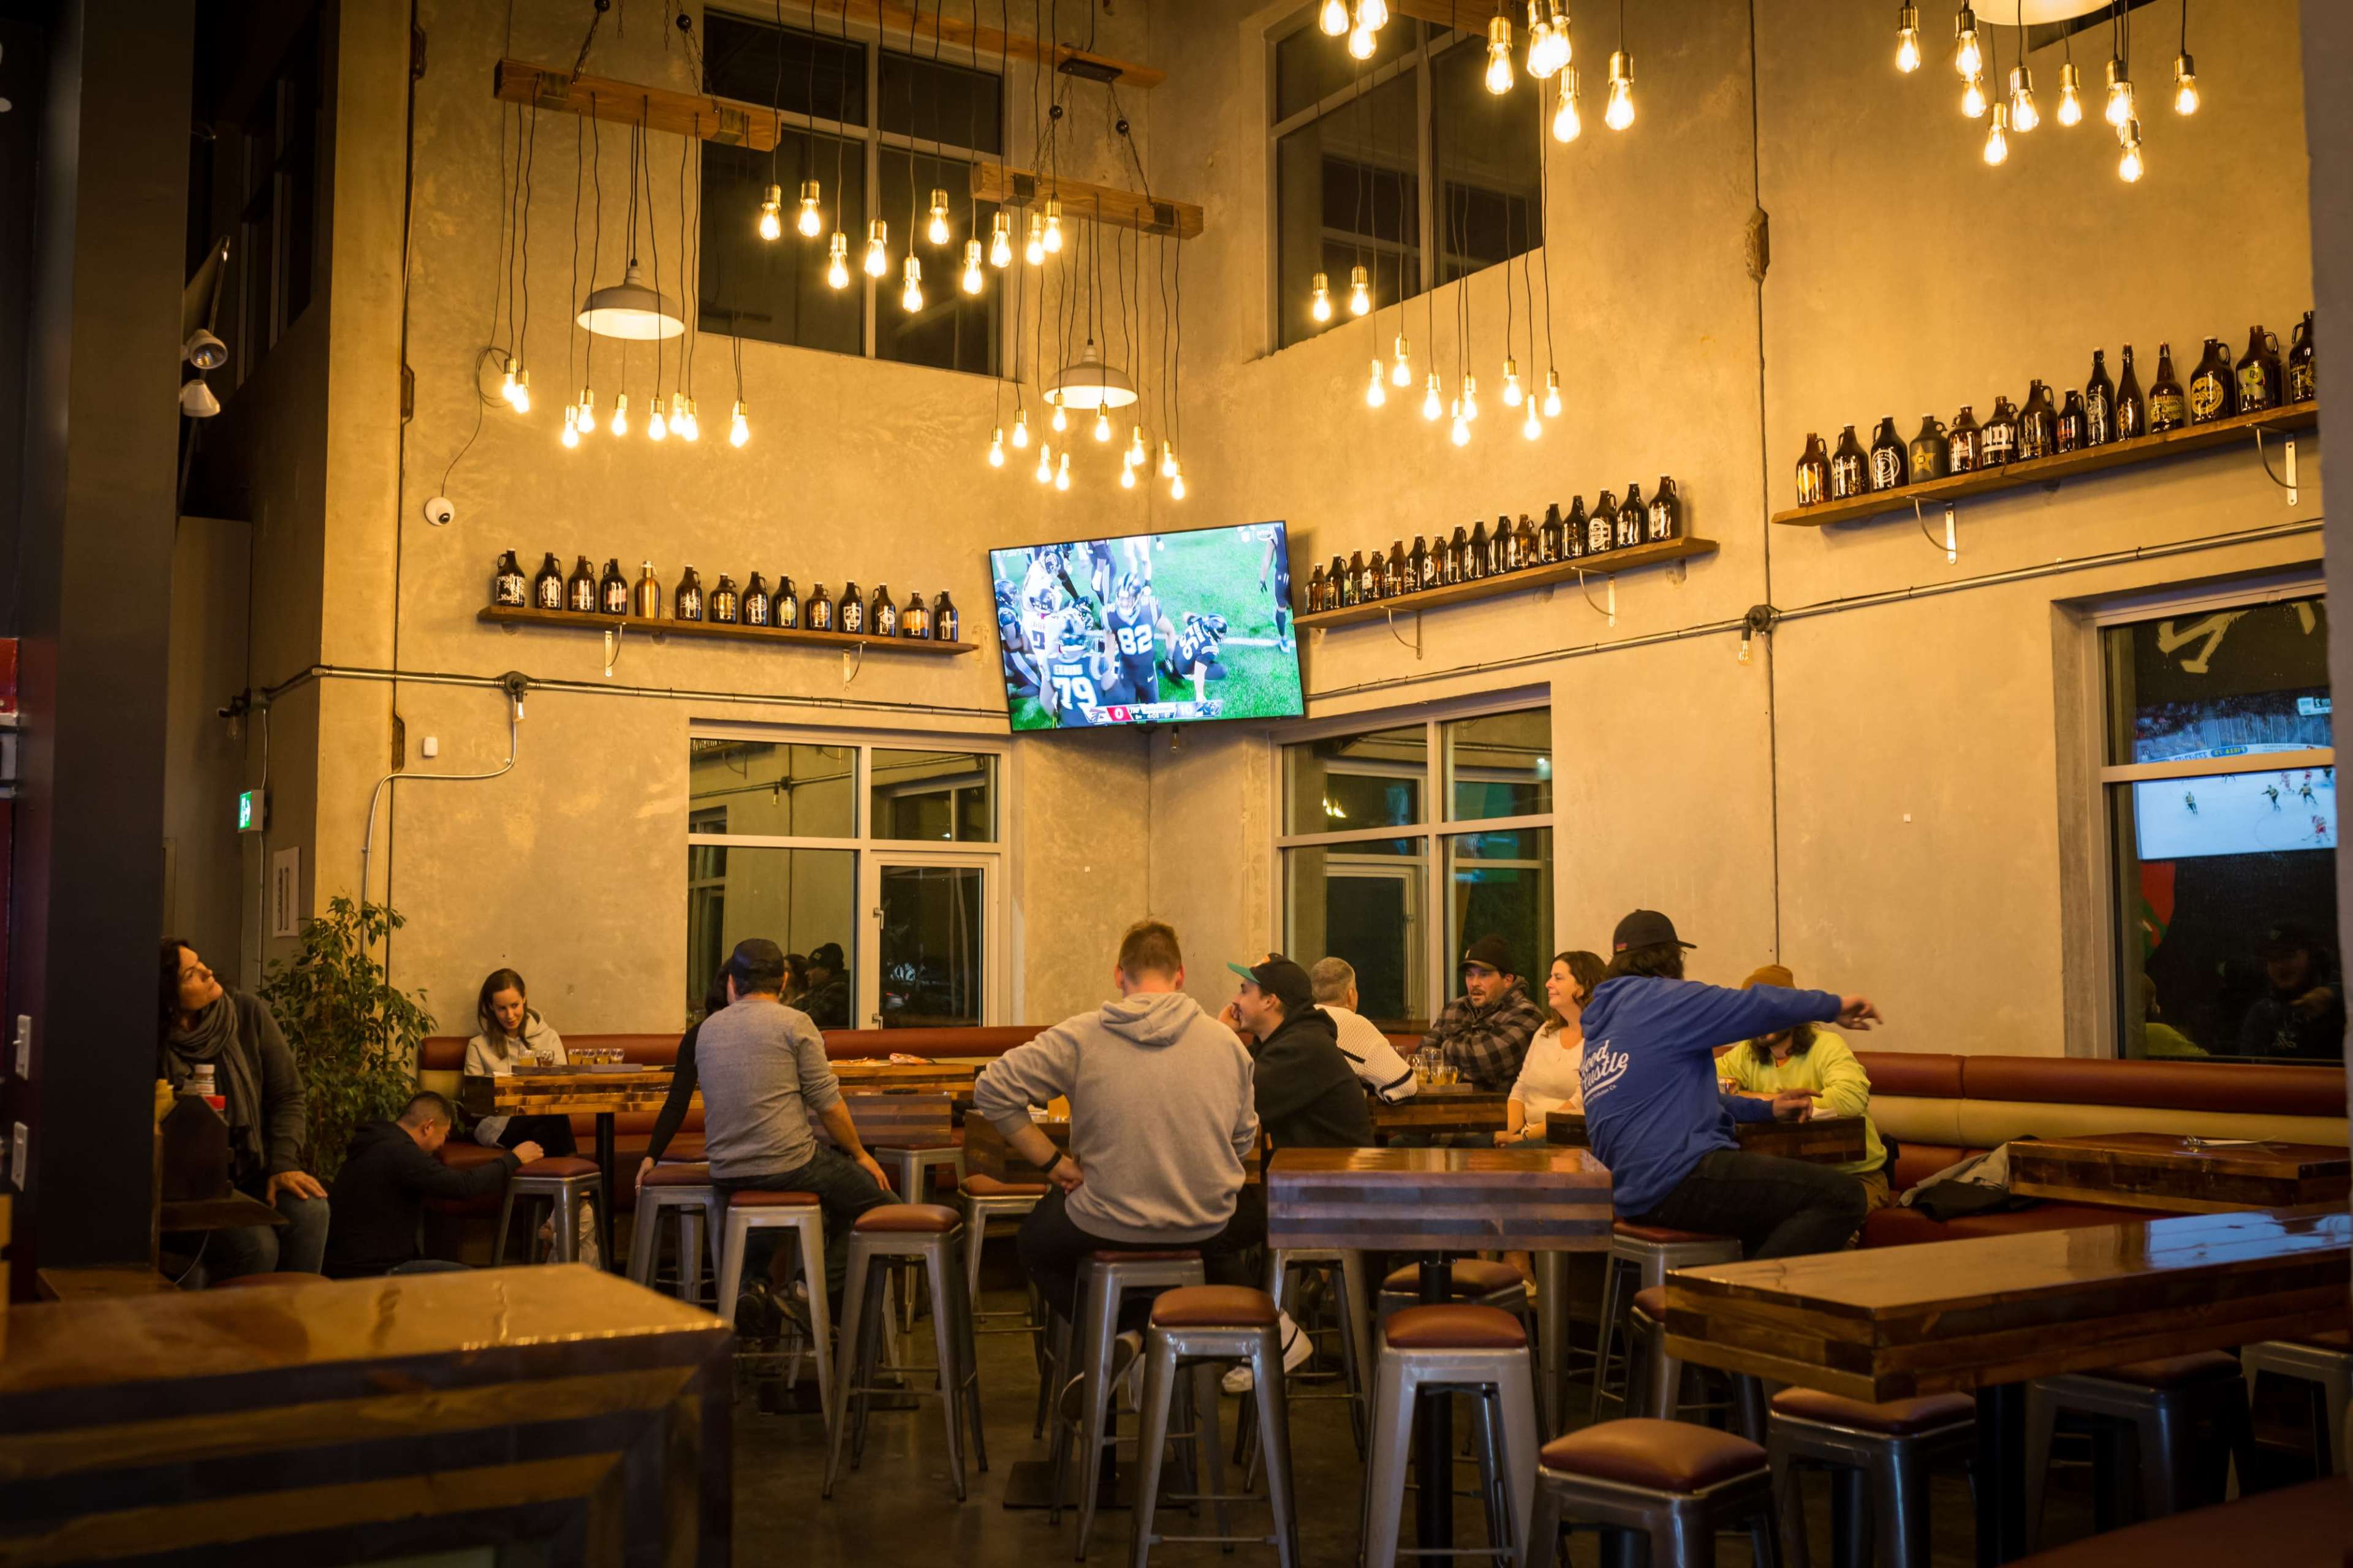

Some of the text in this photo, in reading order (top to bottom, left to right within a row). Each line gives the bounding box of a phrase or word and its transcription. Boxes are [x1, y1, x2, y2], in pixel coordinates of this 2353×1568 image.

[1117, 624, 1153, 655] 82
[1051, 676, 1097, 710] 79
[1114, 708, 1124, 719] 0
